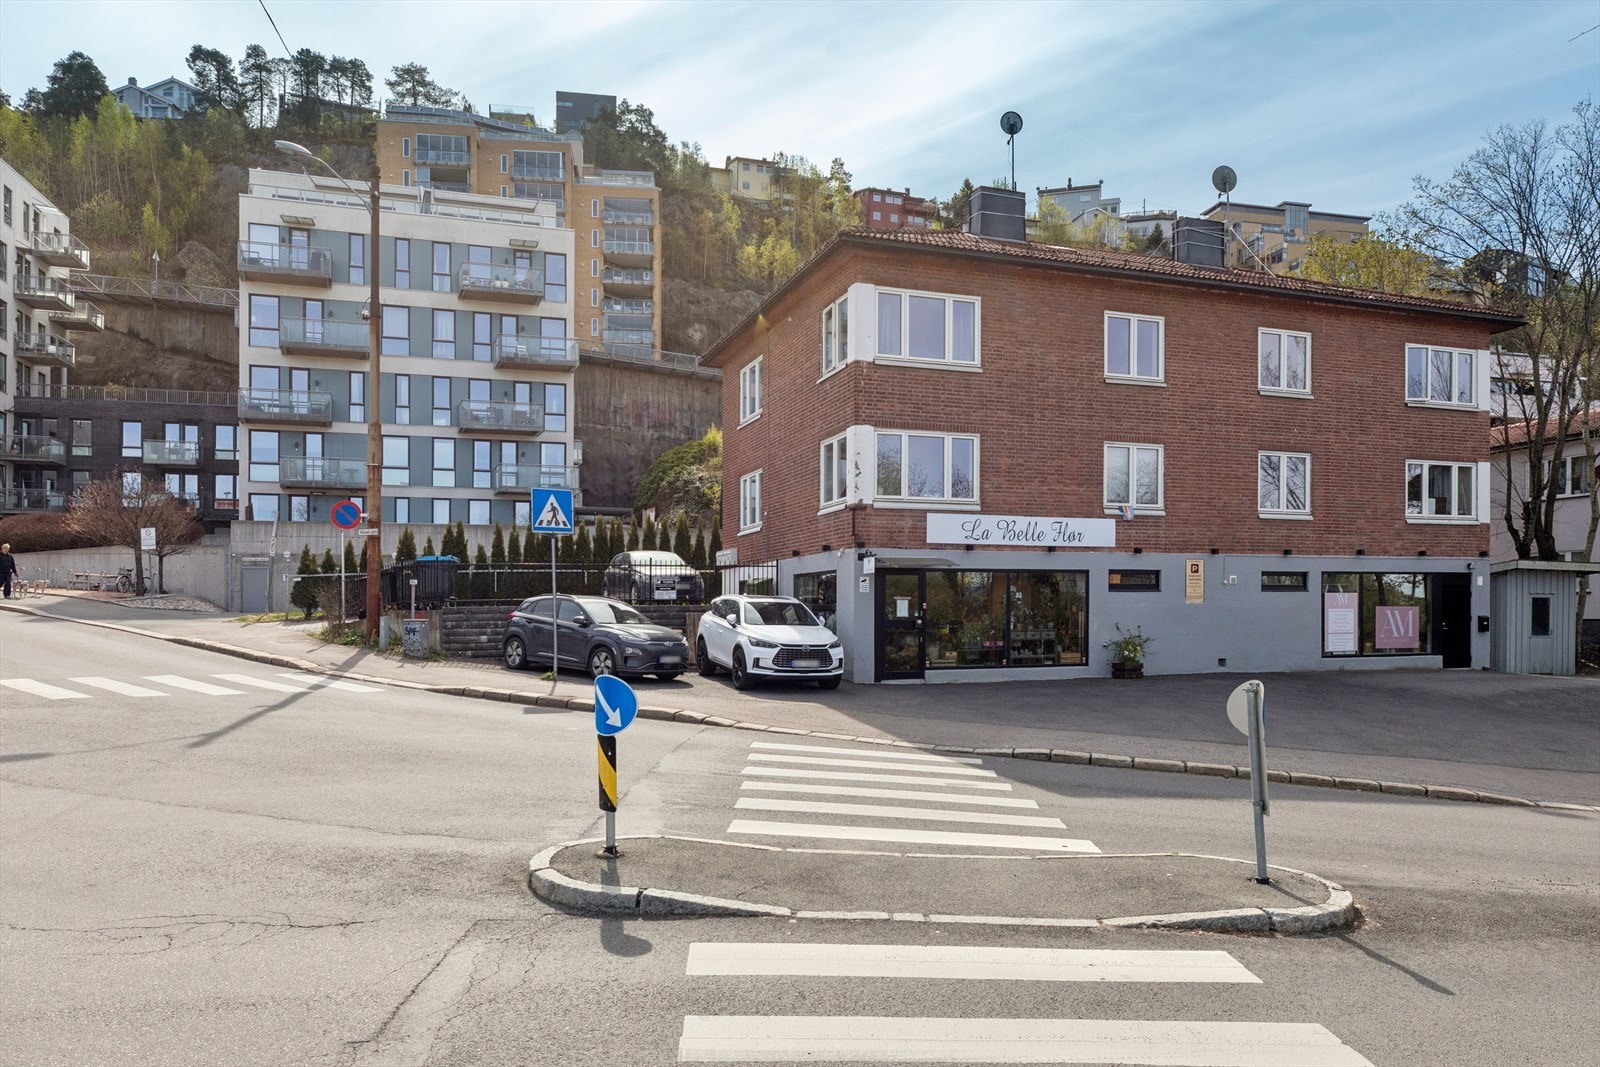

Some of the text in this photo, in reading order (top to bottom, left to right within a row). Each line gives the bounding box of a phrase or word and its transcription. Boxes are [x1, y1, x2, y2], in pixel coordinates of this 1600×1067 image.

[961, 518, 1086, 544] La Belle Flør
